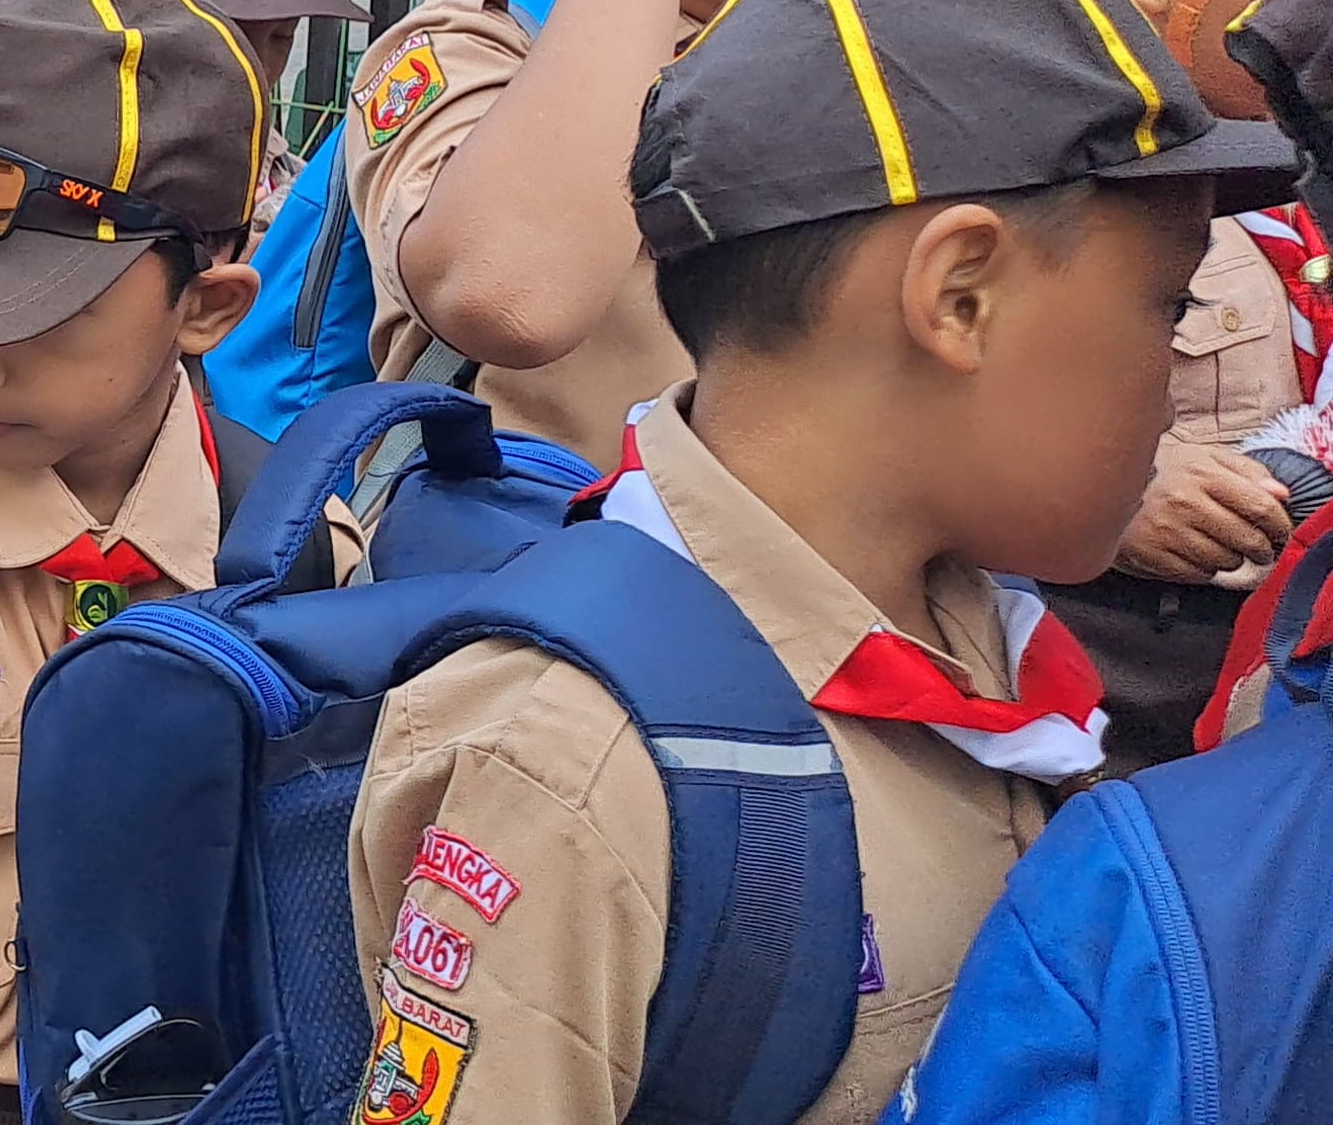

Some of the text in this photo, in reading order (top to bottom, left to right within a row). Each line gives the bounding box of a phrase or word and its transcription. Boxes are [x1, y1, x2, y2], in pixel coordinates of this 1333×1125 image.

[60, 179, 103, 208] SKY X
[401, 996, 467, 1039] BARAT
